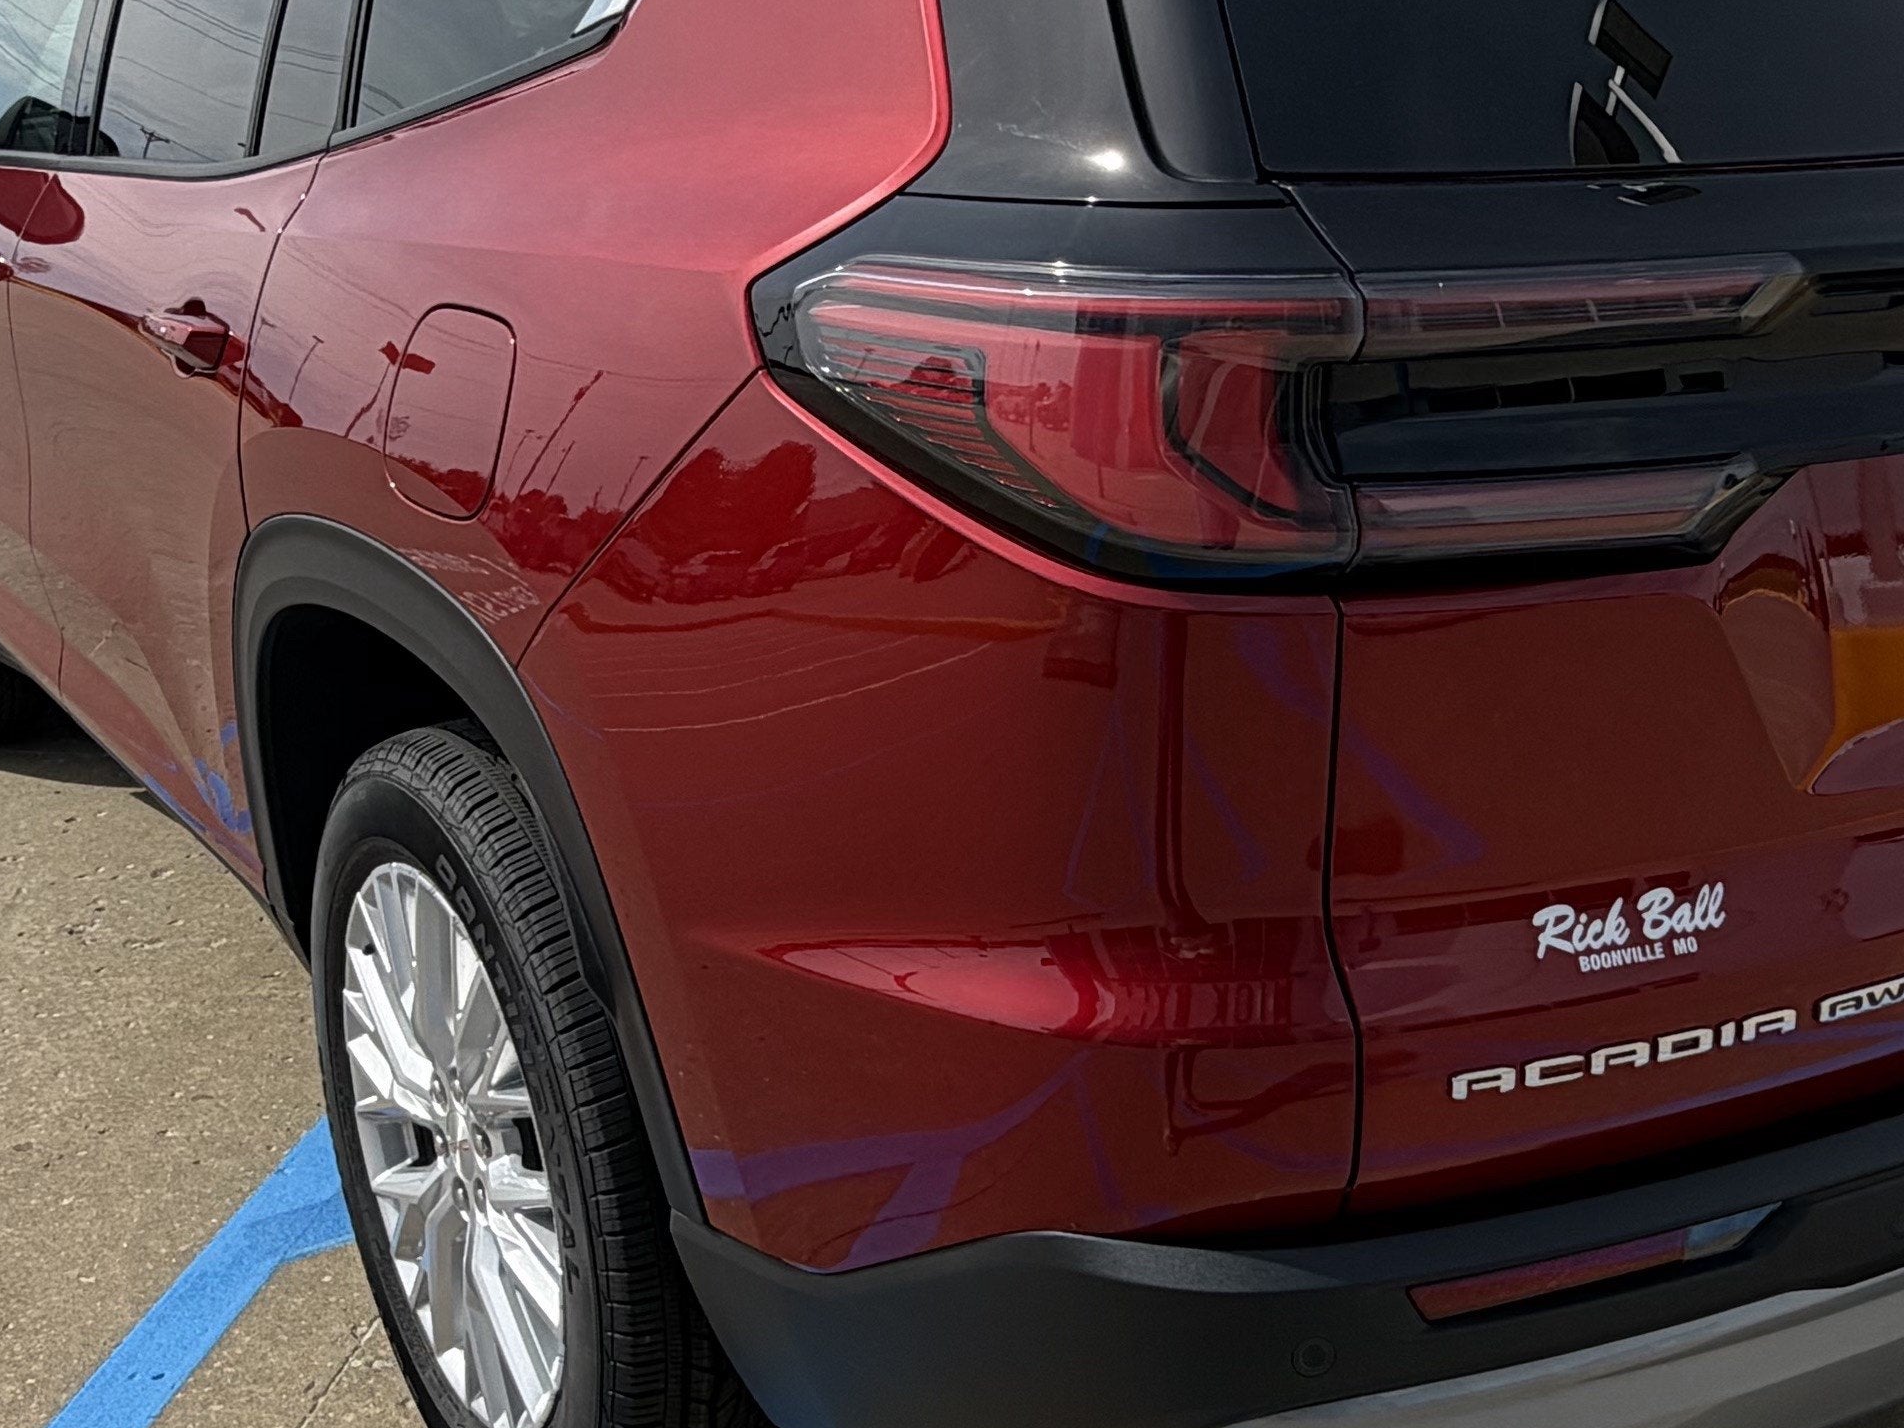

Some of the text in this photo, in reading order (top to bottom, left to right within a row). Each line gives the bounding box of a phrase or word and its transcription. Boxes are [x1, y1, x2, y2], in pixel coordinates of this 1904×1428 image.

[1532, 881, 1727, 959] Rick Ball
[1579, 936, 1698, 973] BOONVILLE MO
[1450, 1008, 1798, 1101] ACADIA
